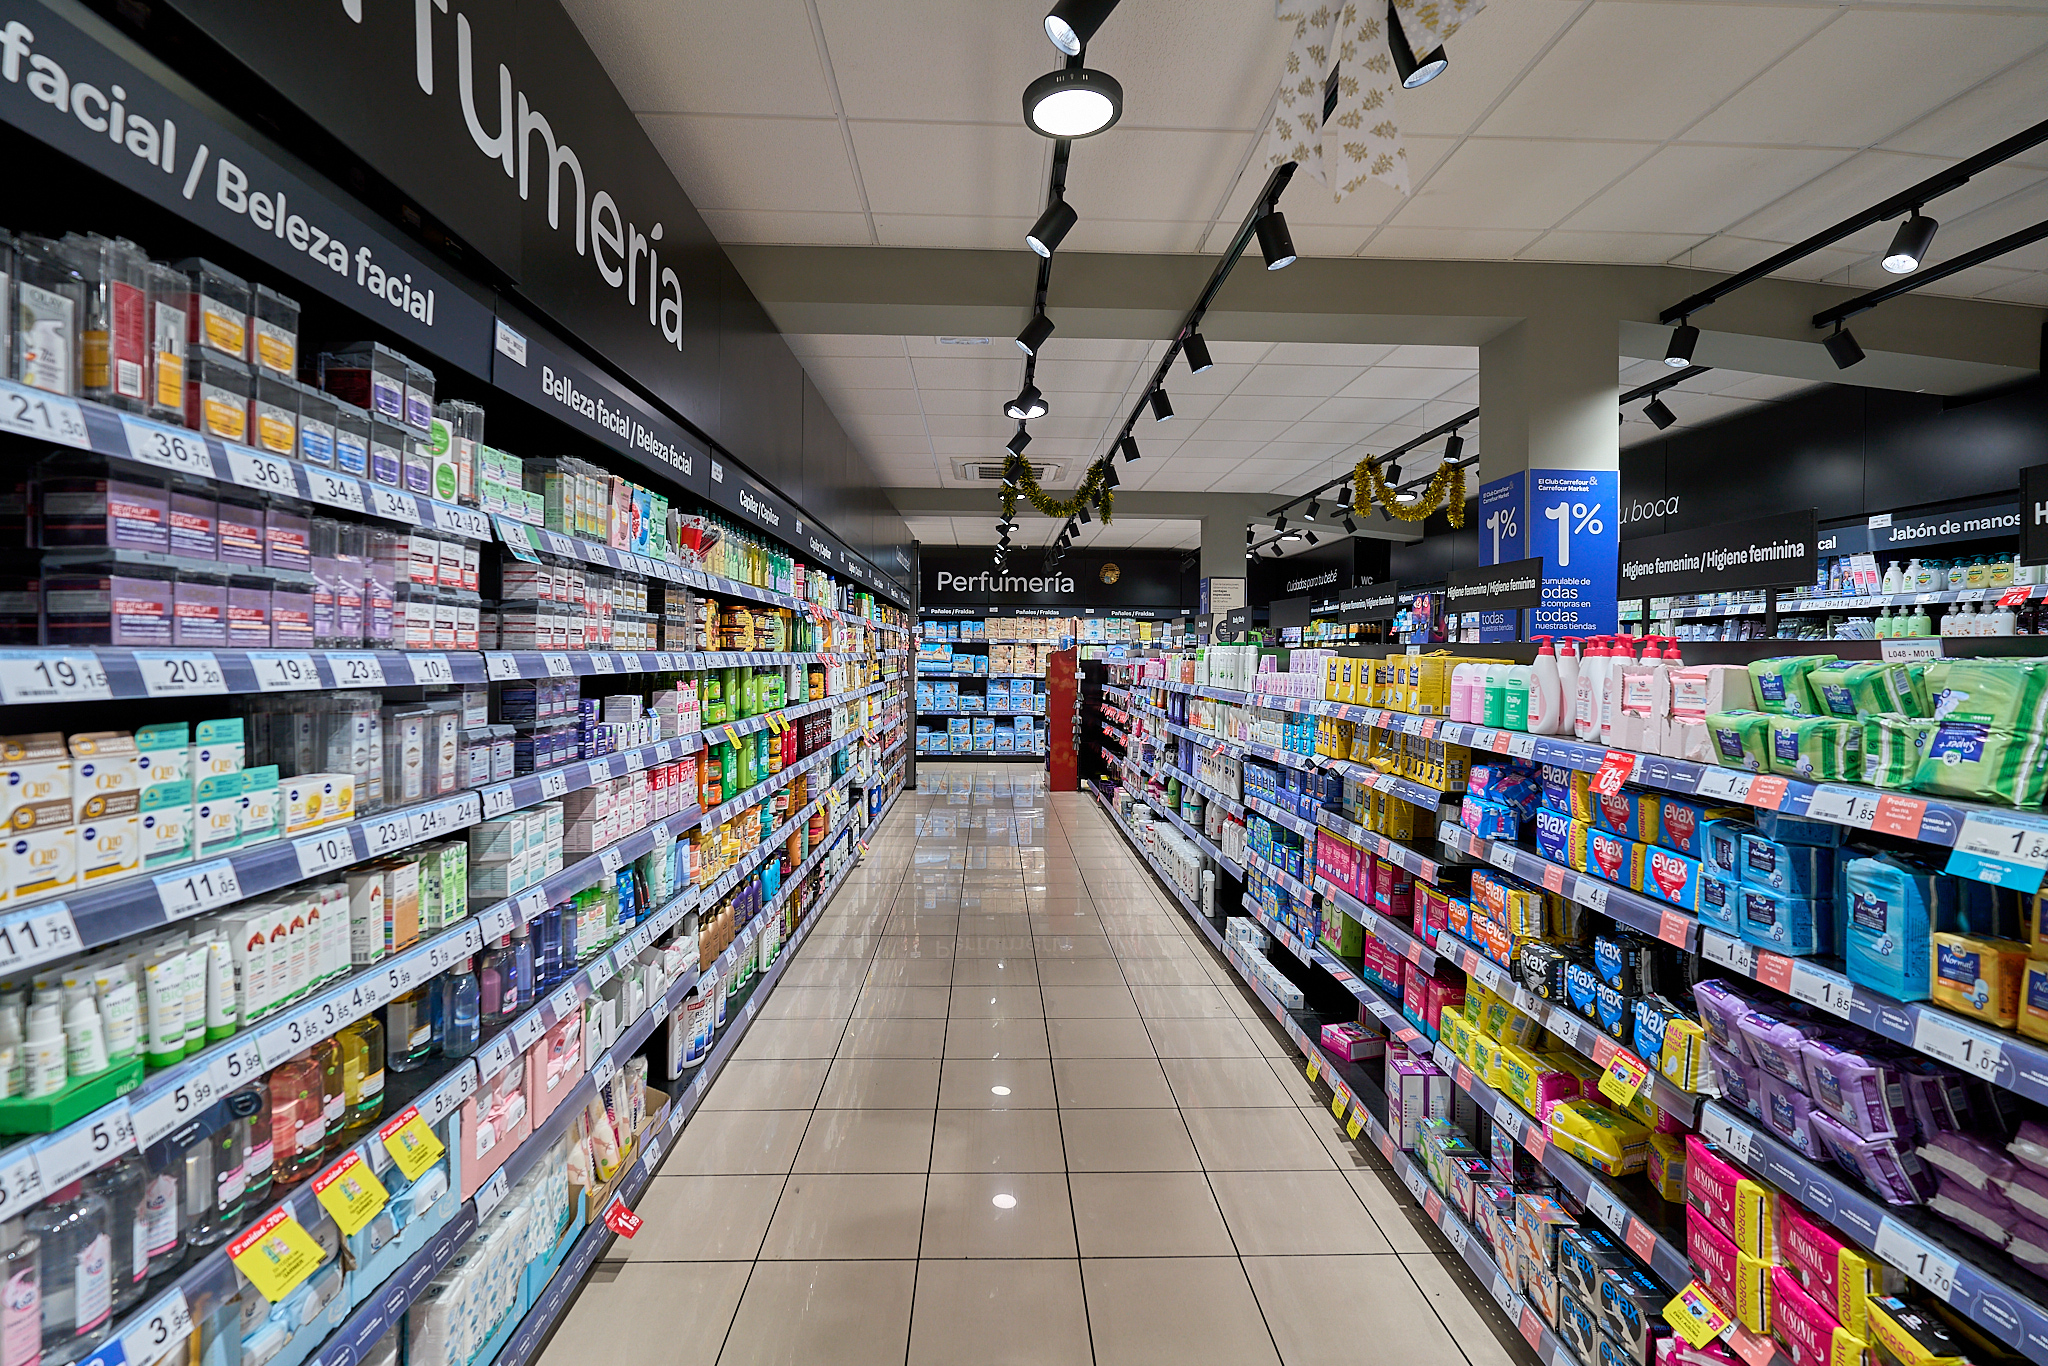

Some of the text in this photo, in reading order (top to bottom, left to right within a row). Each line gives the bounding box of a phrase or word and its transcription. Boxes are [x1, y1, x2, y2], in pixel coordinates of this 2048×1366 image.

[0, 20, 435, 327] facial / Beleza facial
[542, 366, 692, 476] Belleza facial / Beleza facial
[153, 430, 210, 468] 36,70
[1589, 476, 1597, 485] &
[1630, 494, 1680, 523] boca
[1486, 507, 1517, 565] 1%
[1545, 502, 1603, 567] 1%
[1888, 523, 1937, 542] Jabón
[1939, 519, 1962, 535] de
[1622, 540, 1806, 581] Higiene femenina / Higiene feminina
[937, 571, 1075, 593] Perfumería
[1361, 576, 1373, 585] WC
[1447, 585, 1464, 598] Higiene
[1464, 583, 1486, 595] femenina
[1486, 582, 1490, 596] /
[1490, 580, 1509, 593] Higiene
[1510, 577, 1535, 590] feminina
[1541, 585, 1578, 599] odas
[1482, 612, 1504, 624] todas
[1536, 609, 1578, 622] todas
[1888, 649, 1936, 659] L048 M010
[1470, 767, 1489, 779] evax
[1542, 765, 1569, 786] evax
[1729, 776, 1748, 796] 1,40
[1570, 773, 1578, 816] AHORRO
[1847, 797, 1875, 820] 1,85
[1887, 798, 1918, 809] Producto
[1536, 813, 1568, 836] evax
[1664, 803, 1694, 825] evax
[1569, 823, 1577, 867] AHORRO
[1594, 836, 1623, 858] evax
[1652, 853, 1687, 878] evax
[184, 874, 236, 902] 11,05
[1485, 881, 1505, 904] evax
[1449, 902, 1467, 919] evax
[1487, 920, 1512, 945] evax
[1727, 943, 1748, 968] 1,40
[1942, 954, 1974, 969] Normal
[1568, 964, 1596, 992] evax
[353, 988, 376, 1010] 4,99
[1823, 983, 1850, 1011] 1,85
[322, 1004, 349, 1025] 3,65
[1636, 1002, 1667, 1039] evax
[288, 1022, 318, 1044] 3,65
[1668, 1025, 1683, 1041] MÁS
[227, 1053, 260, 1077] 5,99
[1962, 1039, 1998, 1072] 1,07
[1508, 1060, 1530, 1084] evax
[174, 1085, 211, 1112] 5,99
[91, 1122, 135, 1151] 5,99
[1725, 1126, 1747, 1155] 1,15
[1429, 1143, 1444, 1168] evax
[1452, 1164, 1468, 1192] evax
[1694, 1166, 1724, 1201] AUSONIA
[1477, 1189, 1495, 1217] evax
[1517, 1201, 1540, 1235] evax
[1738, 1190, 1746, 1246] AHORRO
[1497, 1223, 1514, 1252] evax
[1694, 1233, 1725, 1269] AUSONIA
[1789, 1229, 1823, 1271] AUSONIA
[1563, 1240, 1594, 1278] evax
[1917, 1253, 1950, 1291] 1,70
[1603, 1282, 1638, 1325] evax
[1739, 1261, 1747, 1318] AHORRO
[1840, 1261, 1851, 1323] AHORRO
[150, 1309, 191, 1344] 3,99
[1564, 1296, 1591, 1336] evax
[1779, 1302, 1817, 1347] AUSONIA
